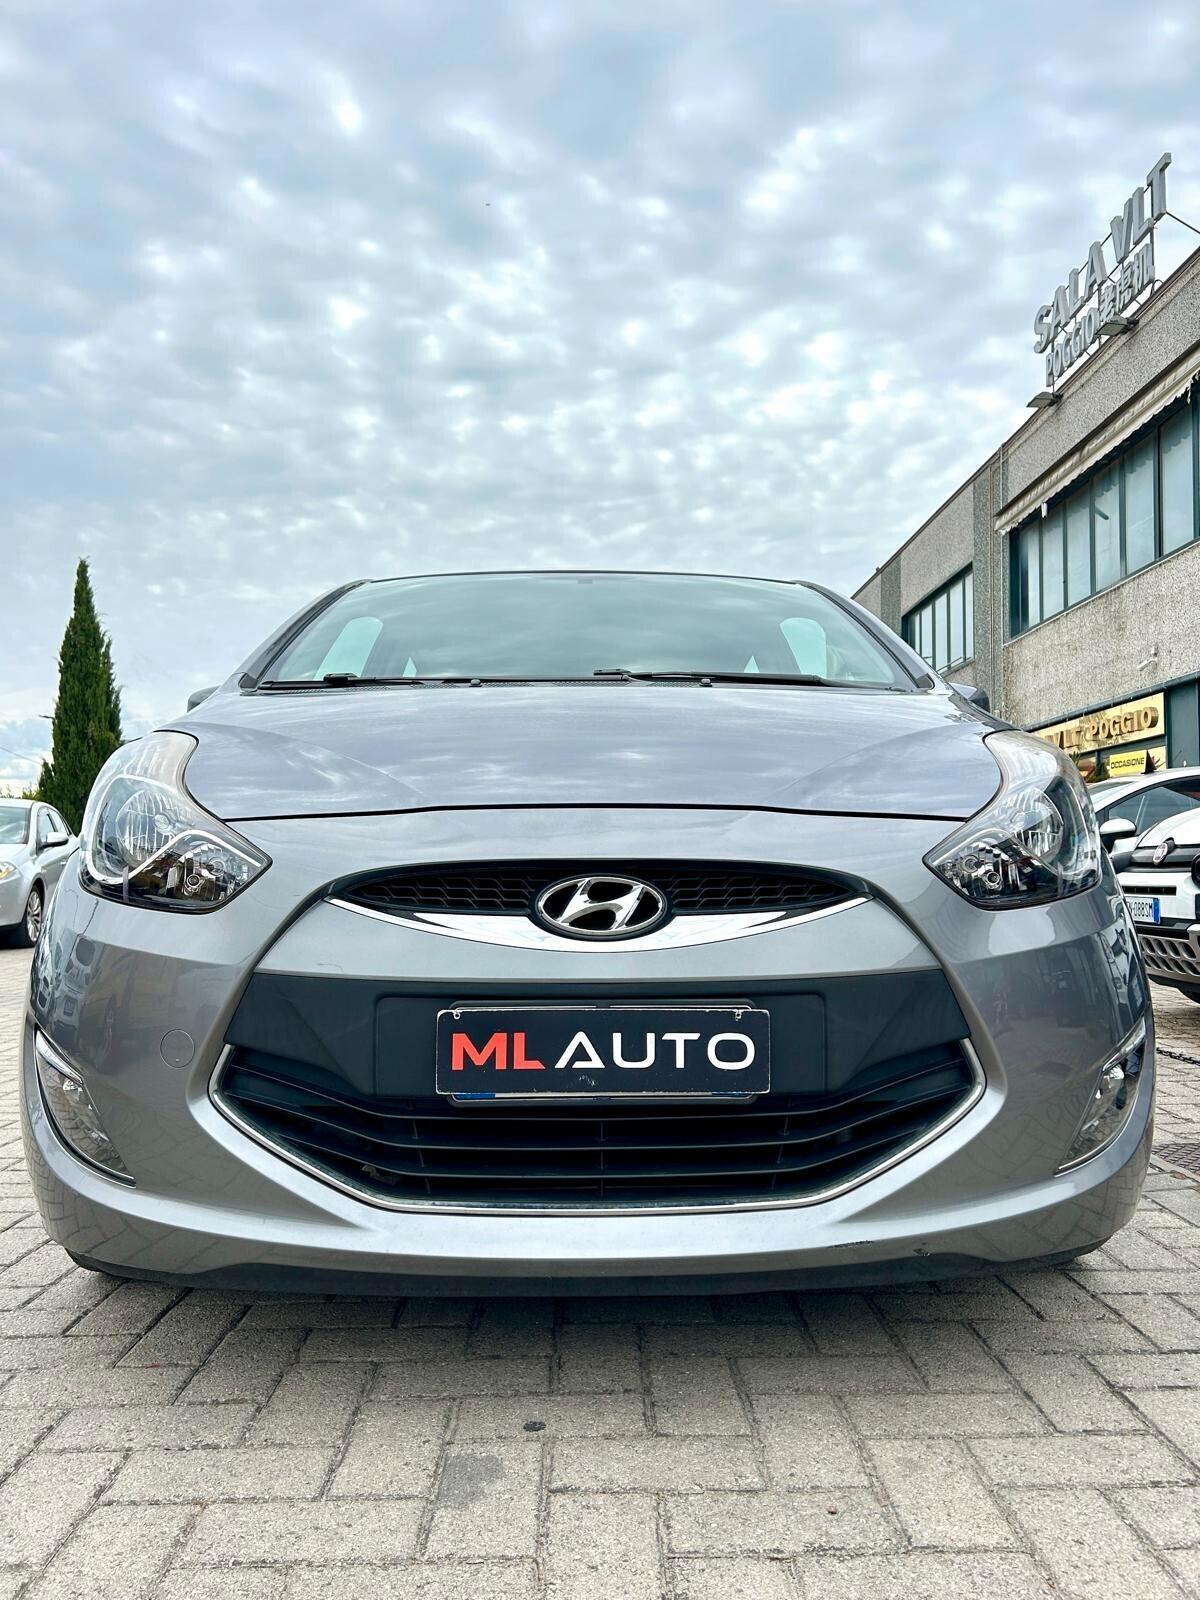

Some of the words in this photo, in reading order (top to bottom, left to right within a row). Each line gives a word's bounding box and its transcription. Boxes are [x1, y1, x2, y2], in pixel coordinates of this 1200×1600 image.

[1034, 241, 1107, 354] SALA
[1110, 152, 1172, 264] VLT
[1046, 307, 1100, 387] POGGIO
[1088, 706, 1159, 740] POGGIO
[1110, 757, 1145, 770] OCCASIONE
[451, 1032, 547, 1071] ML
[553, 1030, 756, 1071] AUTO
